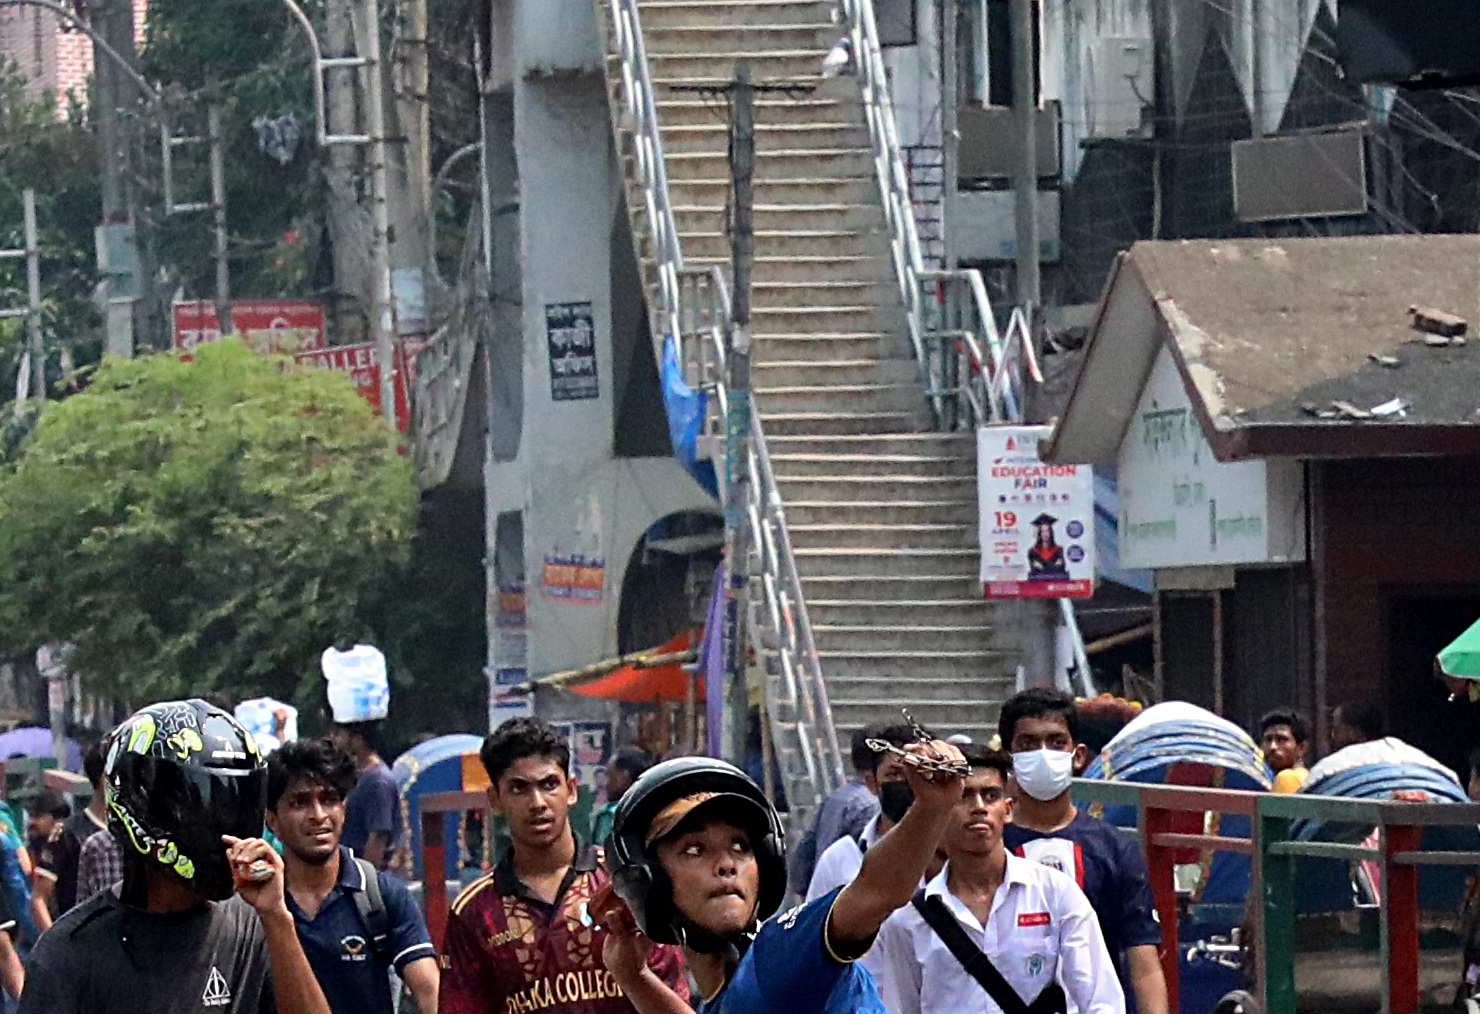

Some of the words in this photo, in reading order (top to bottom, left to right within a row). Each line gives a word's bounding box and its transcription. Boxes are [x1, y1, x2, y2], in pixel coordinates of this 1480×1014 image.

[991, 466, 1077, 478] EDUCATION
[1014, 478, 1047, 489] FAIR
[994, 511, 1018, 527] 19
